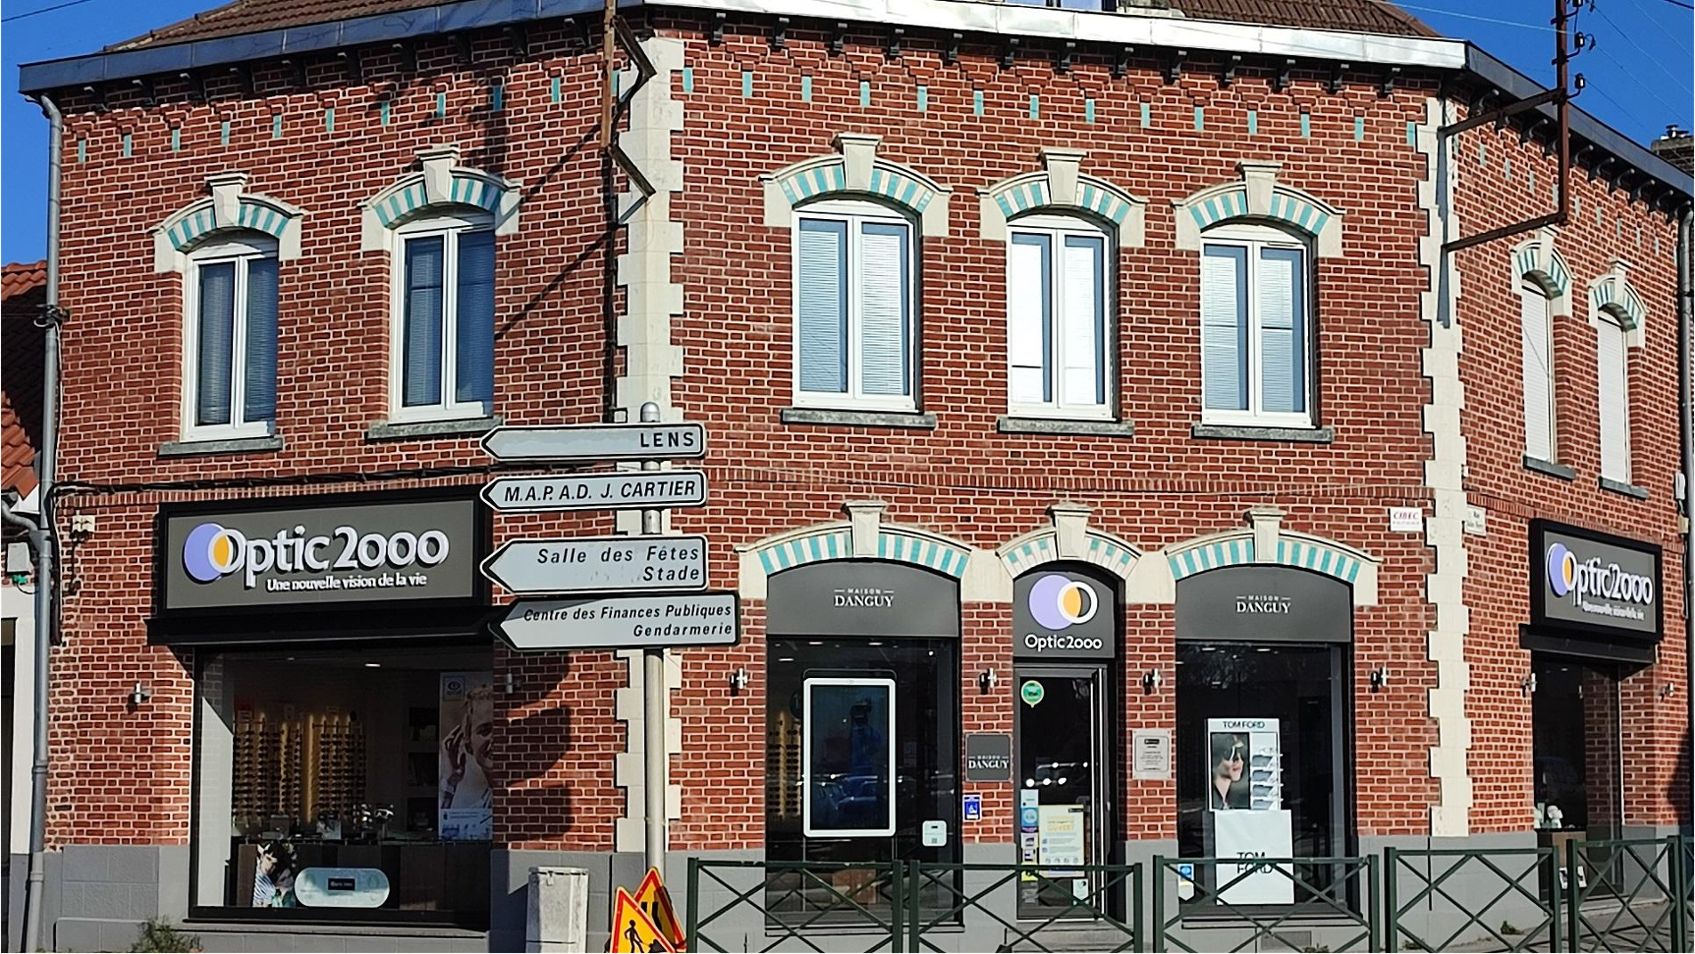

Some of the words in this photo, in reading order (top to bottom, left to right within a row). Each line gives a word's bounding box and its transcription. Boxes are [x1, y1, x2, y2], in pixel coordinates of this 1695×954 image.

[640, 432, 694, 447] LENS
[600, 483, 614, 499] J.
[620, 480, 696, 498] CARTIER
[537, 548, 587, 564] Salle
[600, 547, 633, 562] des
[646, 545, 699, 561] Fêtes
[643, 565, 700, 581] Stade
[266, 579, 290, 592] Une
[292, 575, 341, 590] nouvelle
[342, 574, 377, 588] vision
[378, 573, 393, 586] de
[395, 573, 407, 585] la
[409, 572, 427, 585] vie
[834, 595, 894, 607] DANGUY
[1236, 601, 1291, 613] DANGUY
[523, 609, 568, 622] Centre
[573, 607, 595, 620] des
[600, 606, 660, 619] Finances
[665, 604, 732, 619] Publiques
[633, 622, 732, 637] Gendarmerie
[1222, 721, 1241, 729] TOM
[1242, 721, 1266, 729] FORD
[968, 760, 1009, 769] DANGUY
